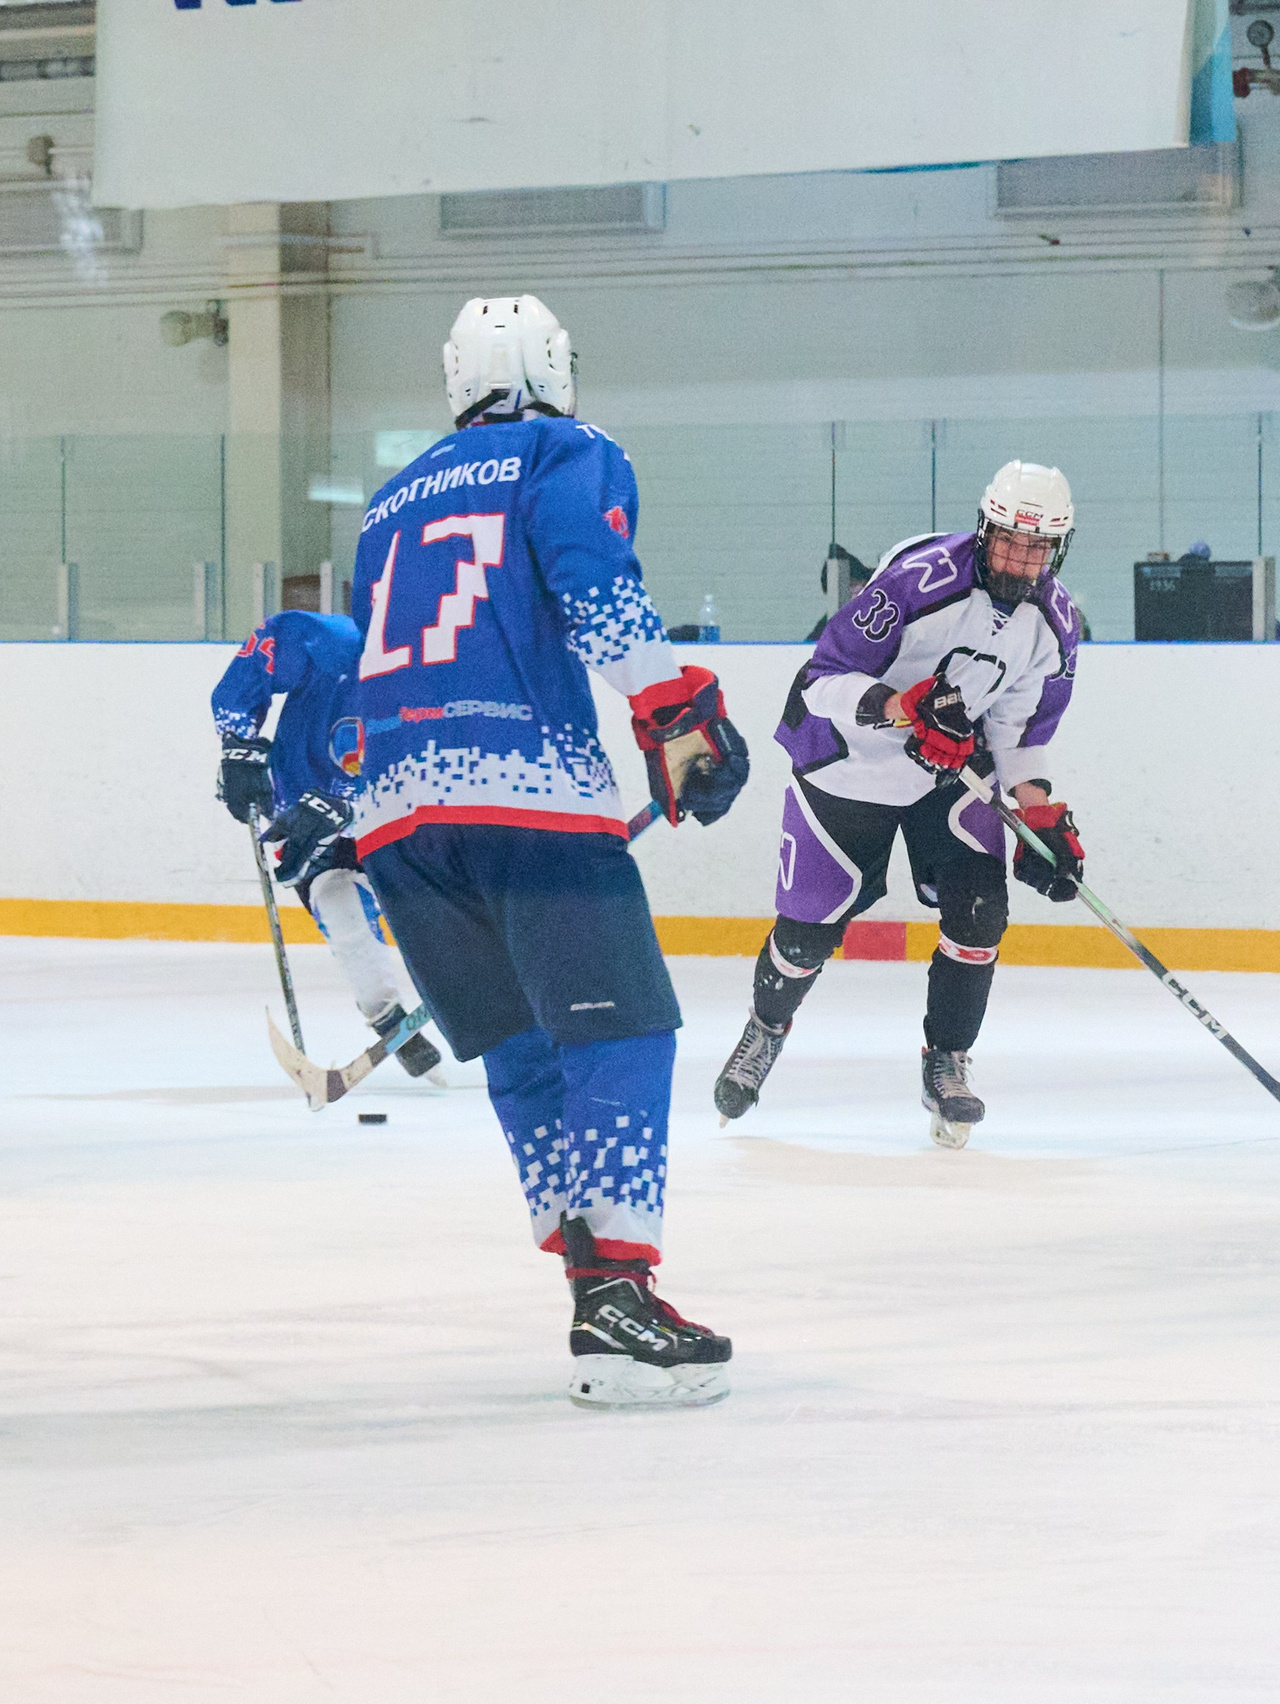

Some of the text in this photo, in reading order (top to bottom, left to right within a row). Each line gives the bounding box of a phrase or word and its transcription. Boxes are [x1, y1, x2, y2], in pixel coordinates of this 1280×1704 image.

[360, 456, 522, 533] СКОТНИКОВ
[852, 588, 900, 643] 33
[1162, 971, 1229, 1041] CCM
[595, 1304, 669, 1353] CCM
